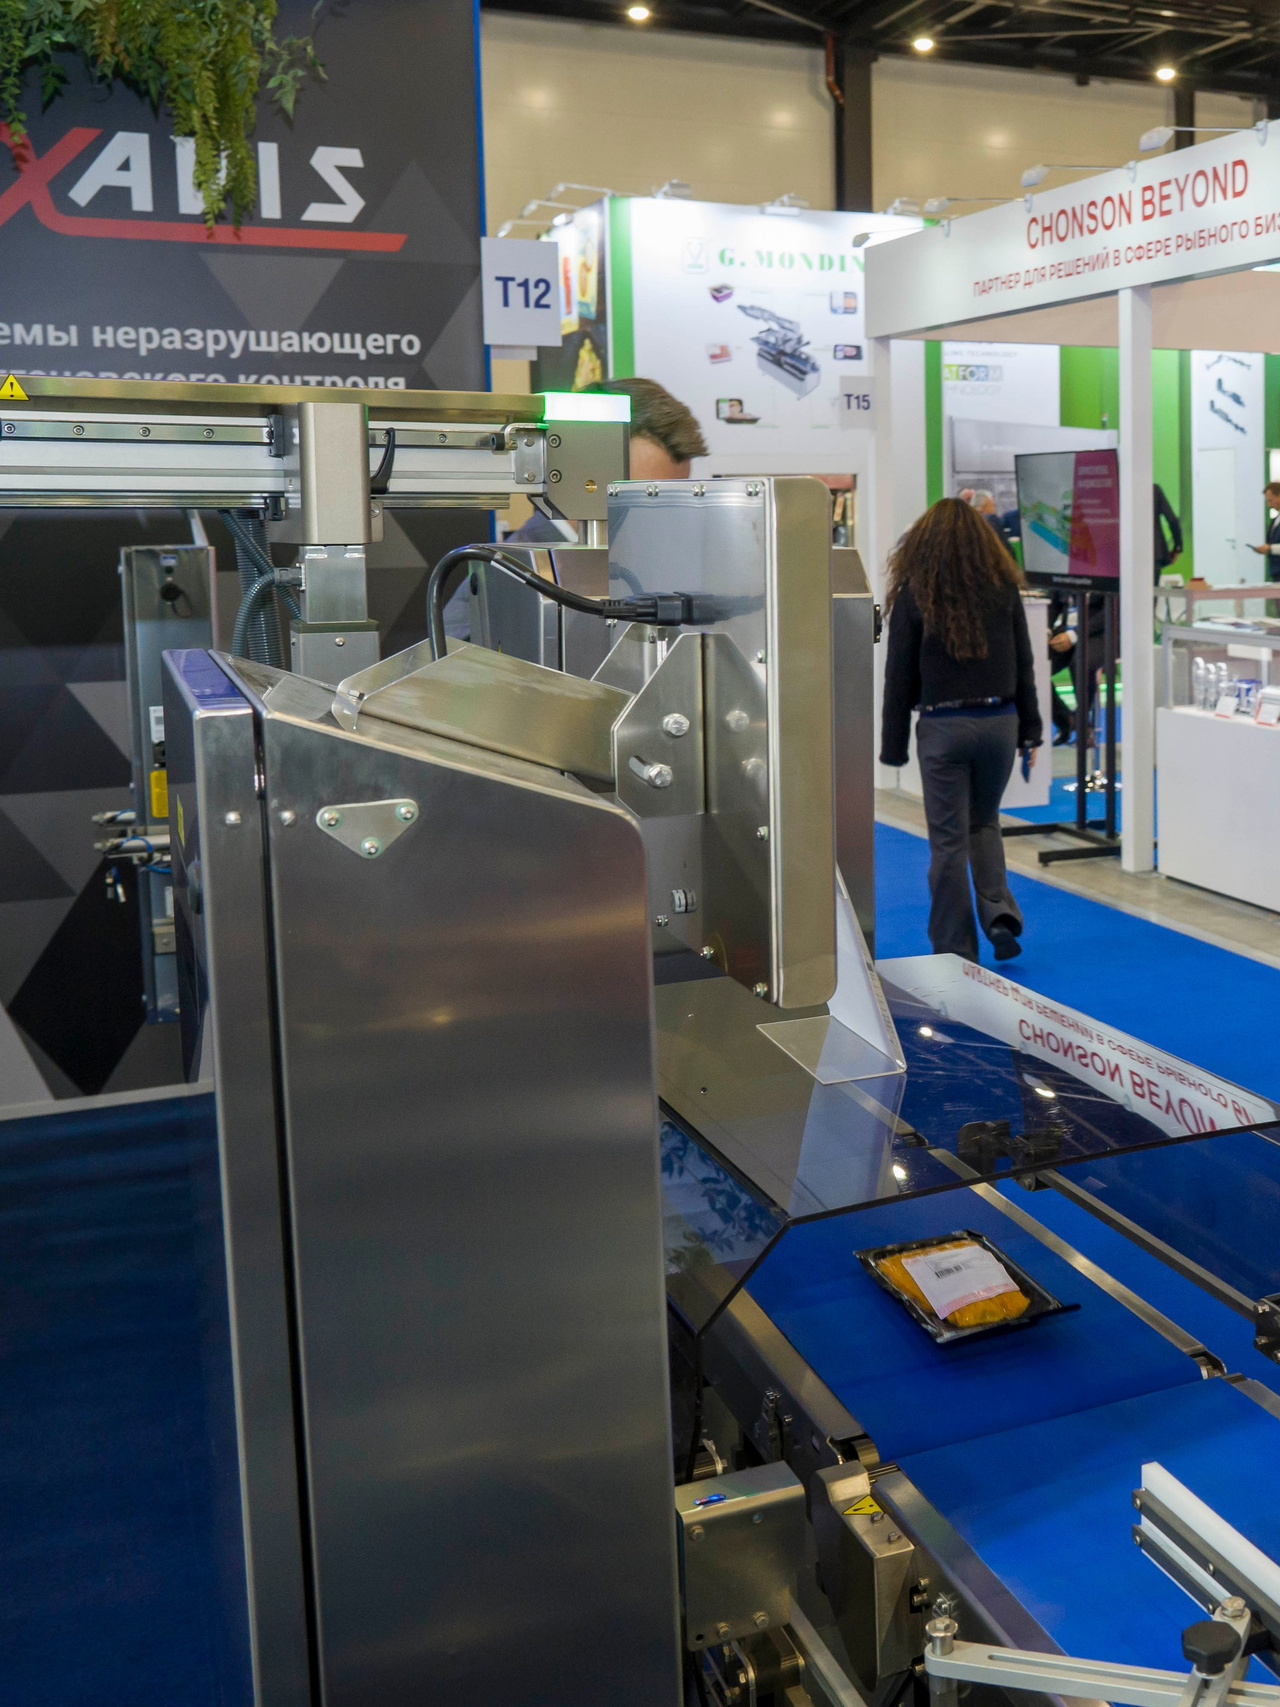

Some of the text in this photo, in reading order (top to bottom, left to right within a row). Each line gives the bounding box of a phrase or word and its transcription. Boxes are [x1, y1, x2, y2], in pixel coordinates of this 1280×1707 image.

[1027, 159, 1249, 249] CHONSON BEYOND
[718, 248, 746, 267] G.
[973, 274, 1021, 297] ПАРТНЕР
[1023, 267, 1046, 288] ДЛЯ
[1050, 248, 1110, 281] РЕШЕНИЙ
[1113, 249, 1121, 267] В
[1124, 237, 1172, 265] СФЕРЕ
[1175, 220, 1249, 251] РЫБНОГО
[495, 276, 551, 309] T12
[92, 324, 422, 361] неразрушающего
[844, 393, 871, 411] T15
